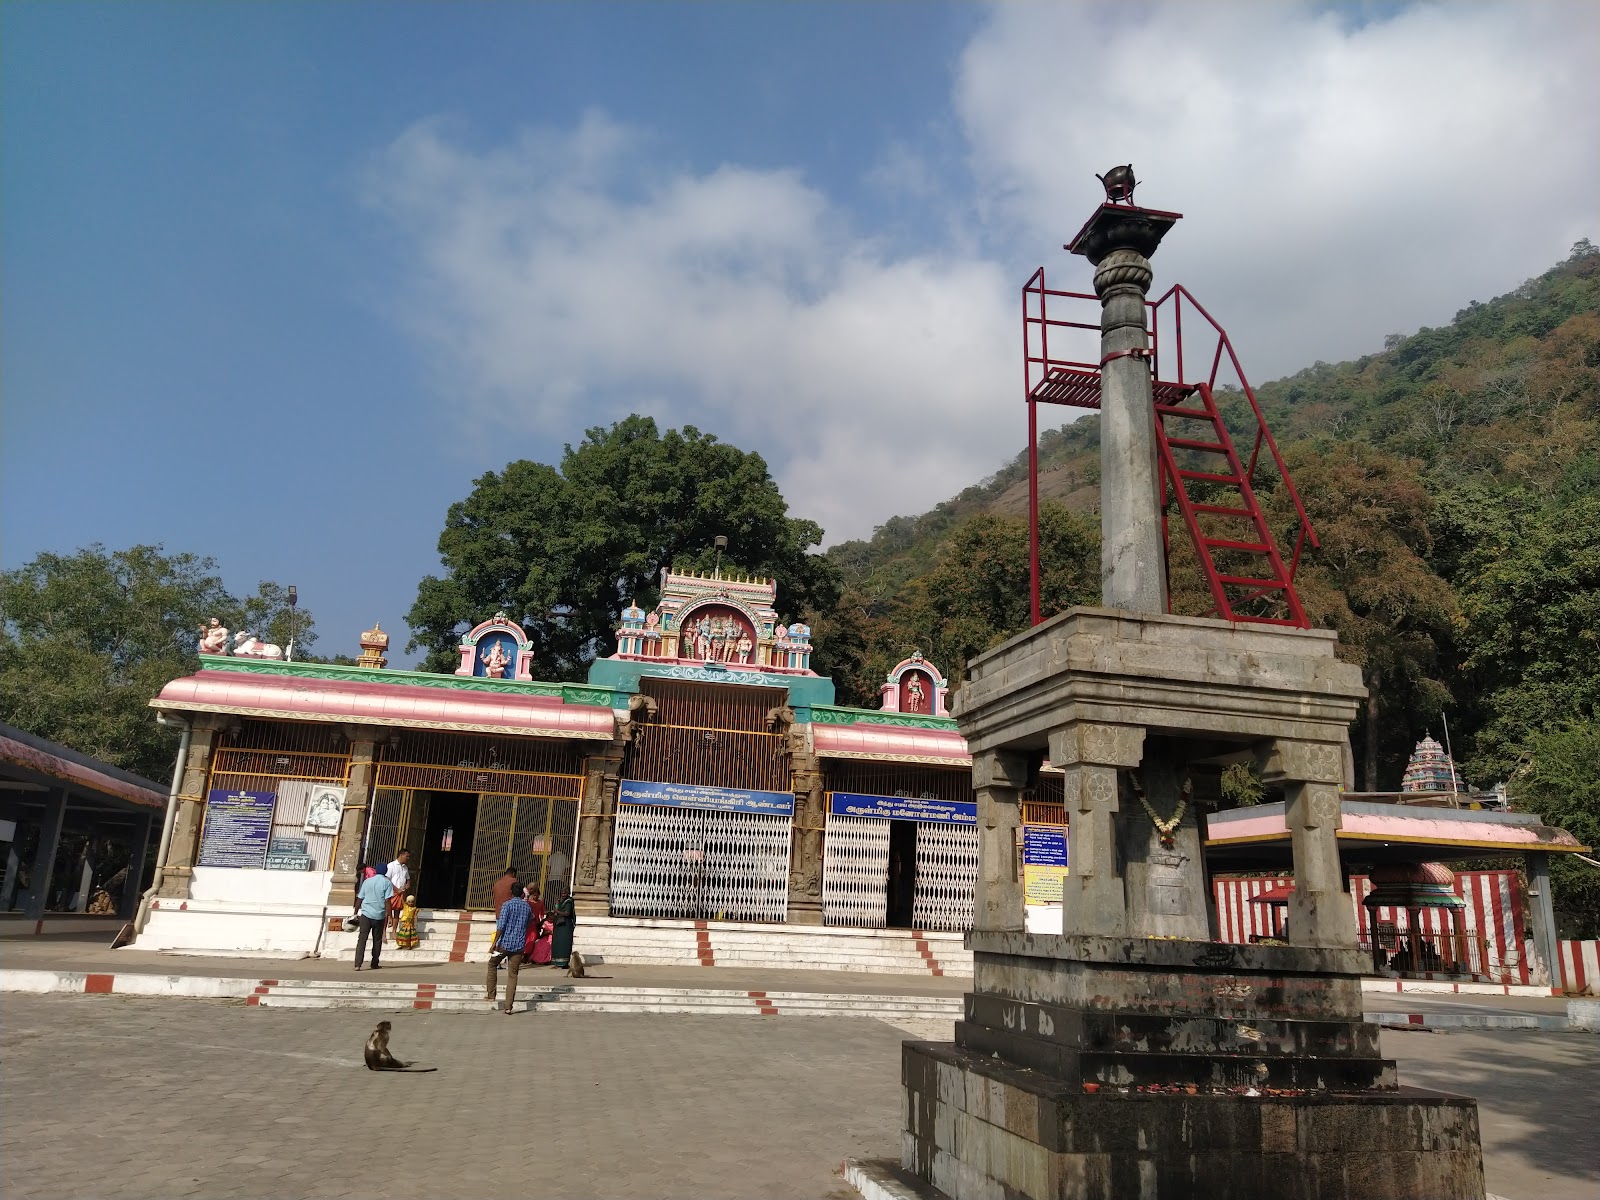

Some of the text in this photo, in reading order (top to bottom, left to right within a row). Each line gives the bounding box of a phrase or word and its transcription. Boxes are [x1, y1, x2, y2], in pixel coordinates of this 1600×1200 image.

[622, 790, 792, 810] அருள்மிகு வெள்ளியங்கிரி ஆண்டவர்
[846, 804, 977, 821] அருள்மிகு மனோன்மணி அம்ம
